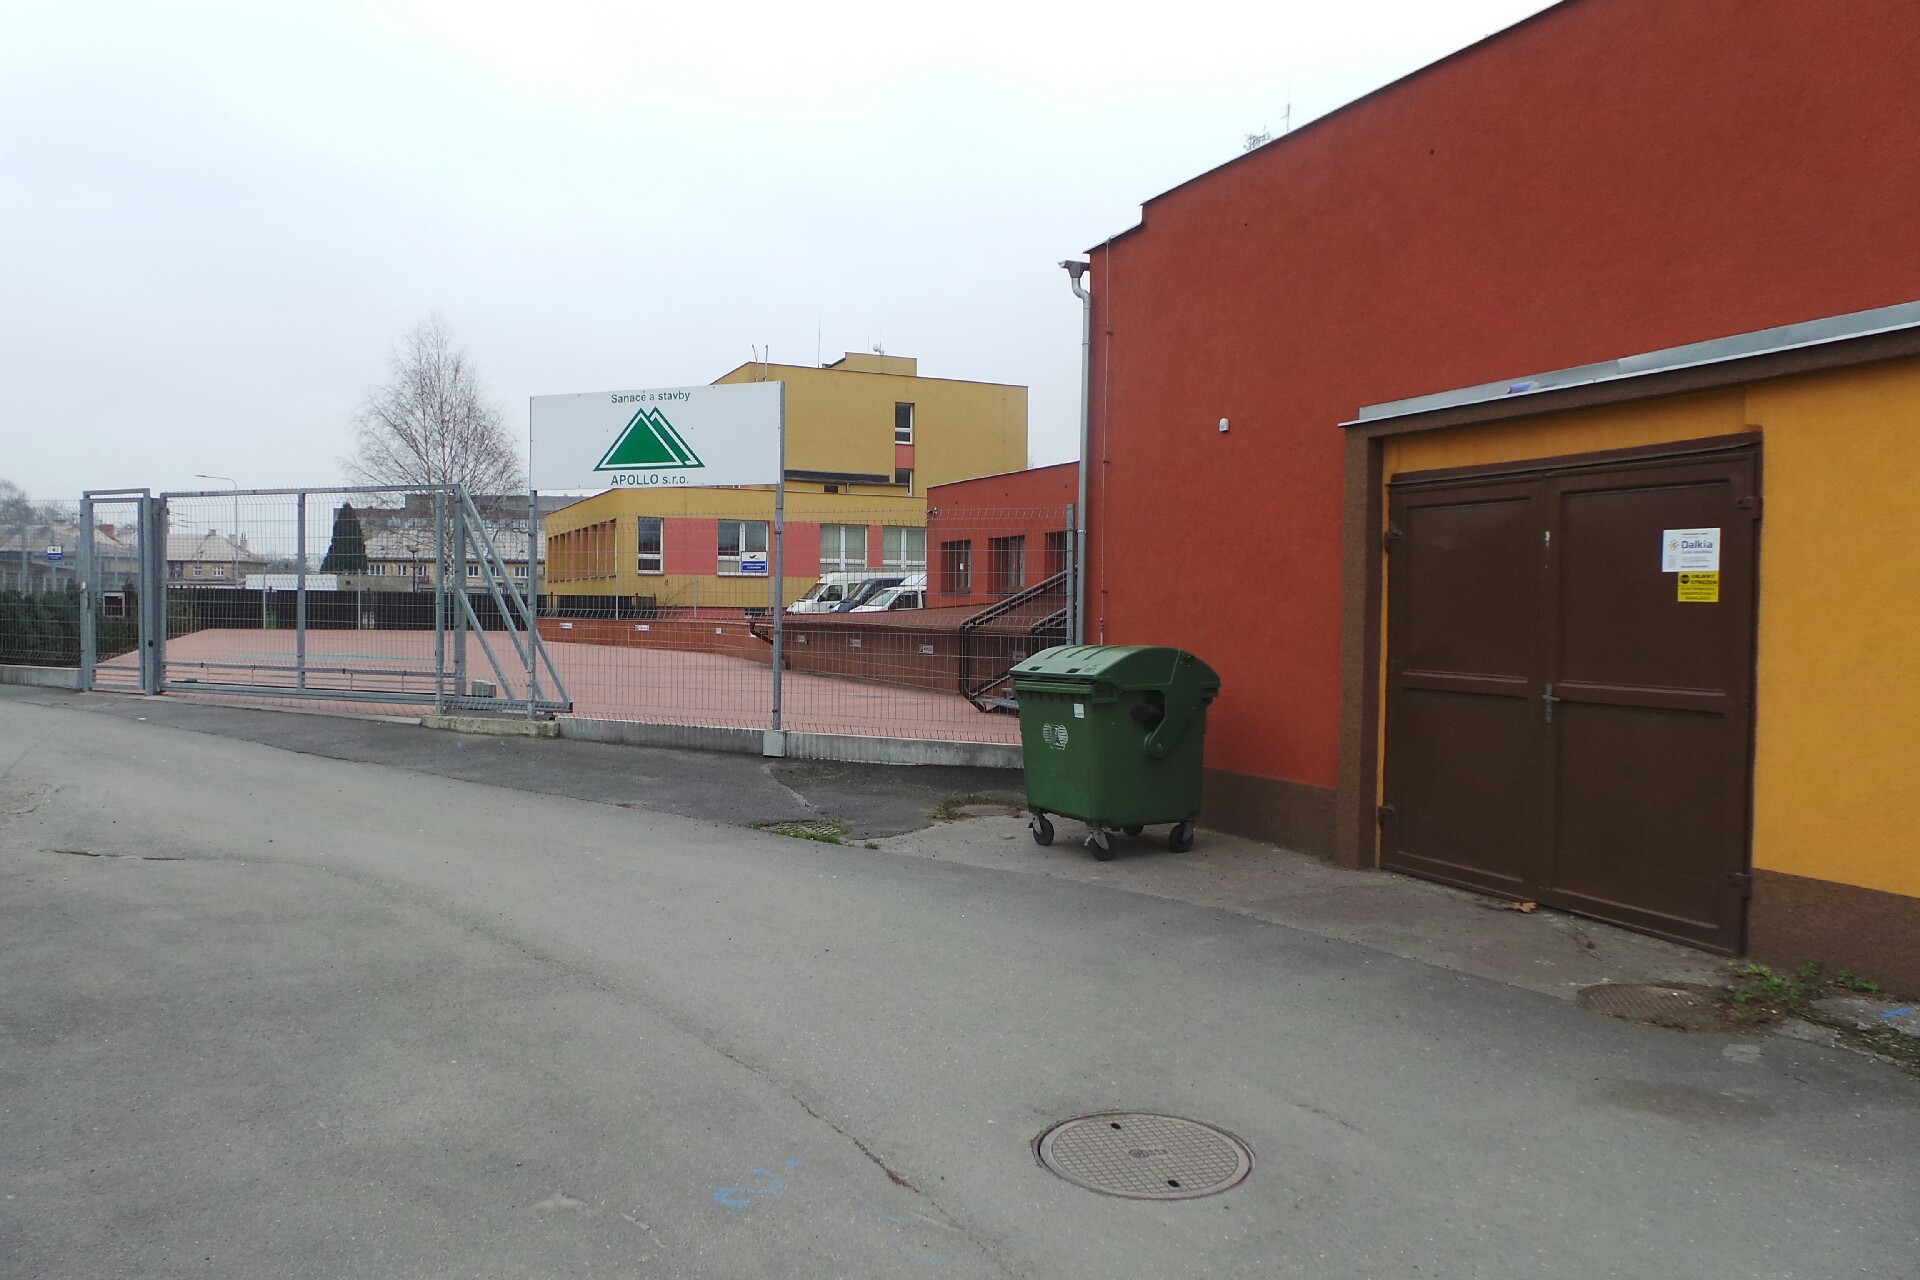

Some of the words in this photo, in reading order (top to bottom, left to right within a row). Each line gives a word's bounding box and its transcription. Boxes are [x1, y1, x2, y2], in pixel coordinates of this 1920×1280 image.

[611, 393, 646, 404] Sanace
[649, 393, 655, 401] a
[657, 390, 691, 402] stavby
[610, 474, 659, 485] APOLLO
[662, 475, 689, 484] s.r.o.
[1681, 540, 1713, 549] Dalkia
